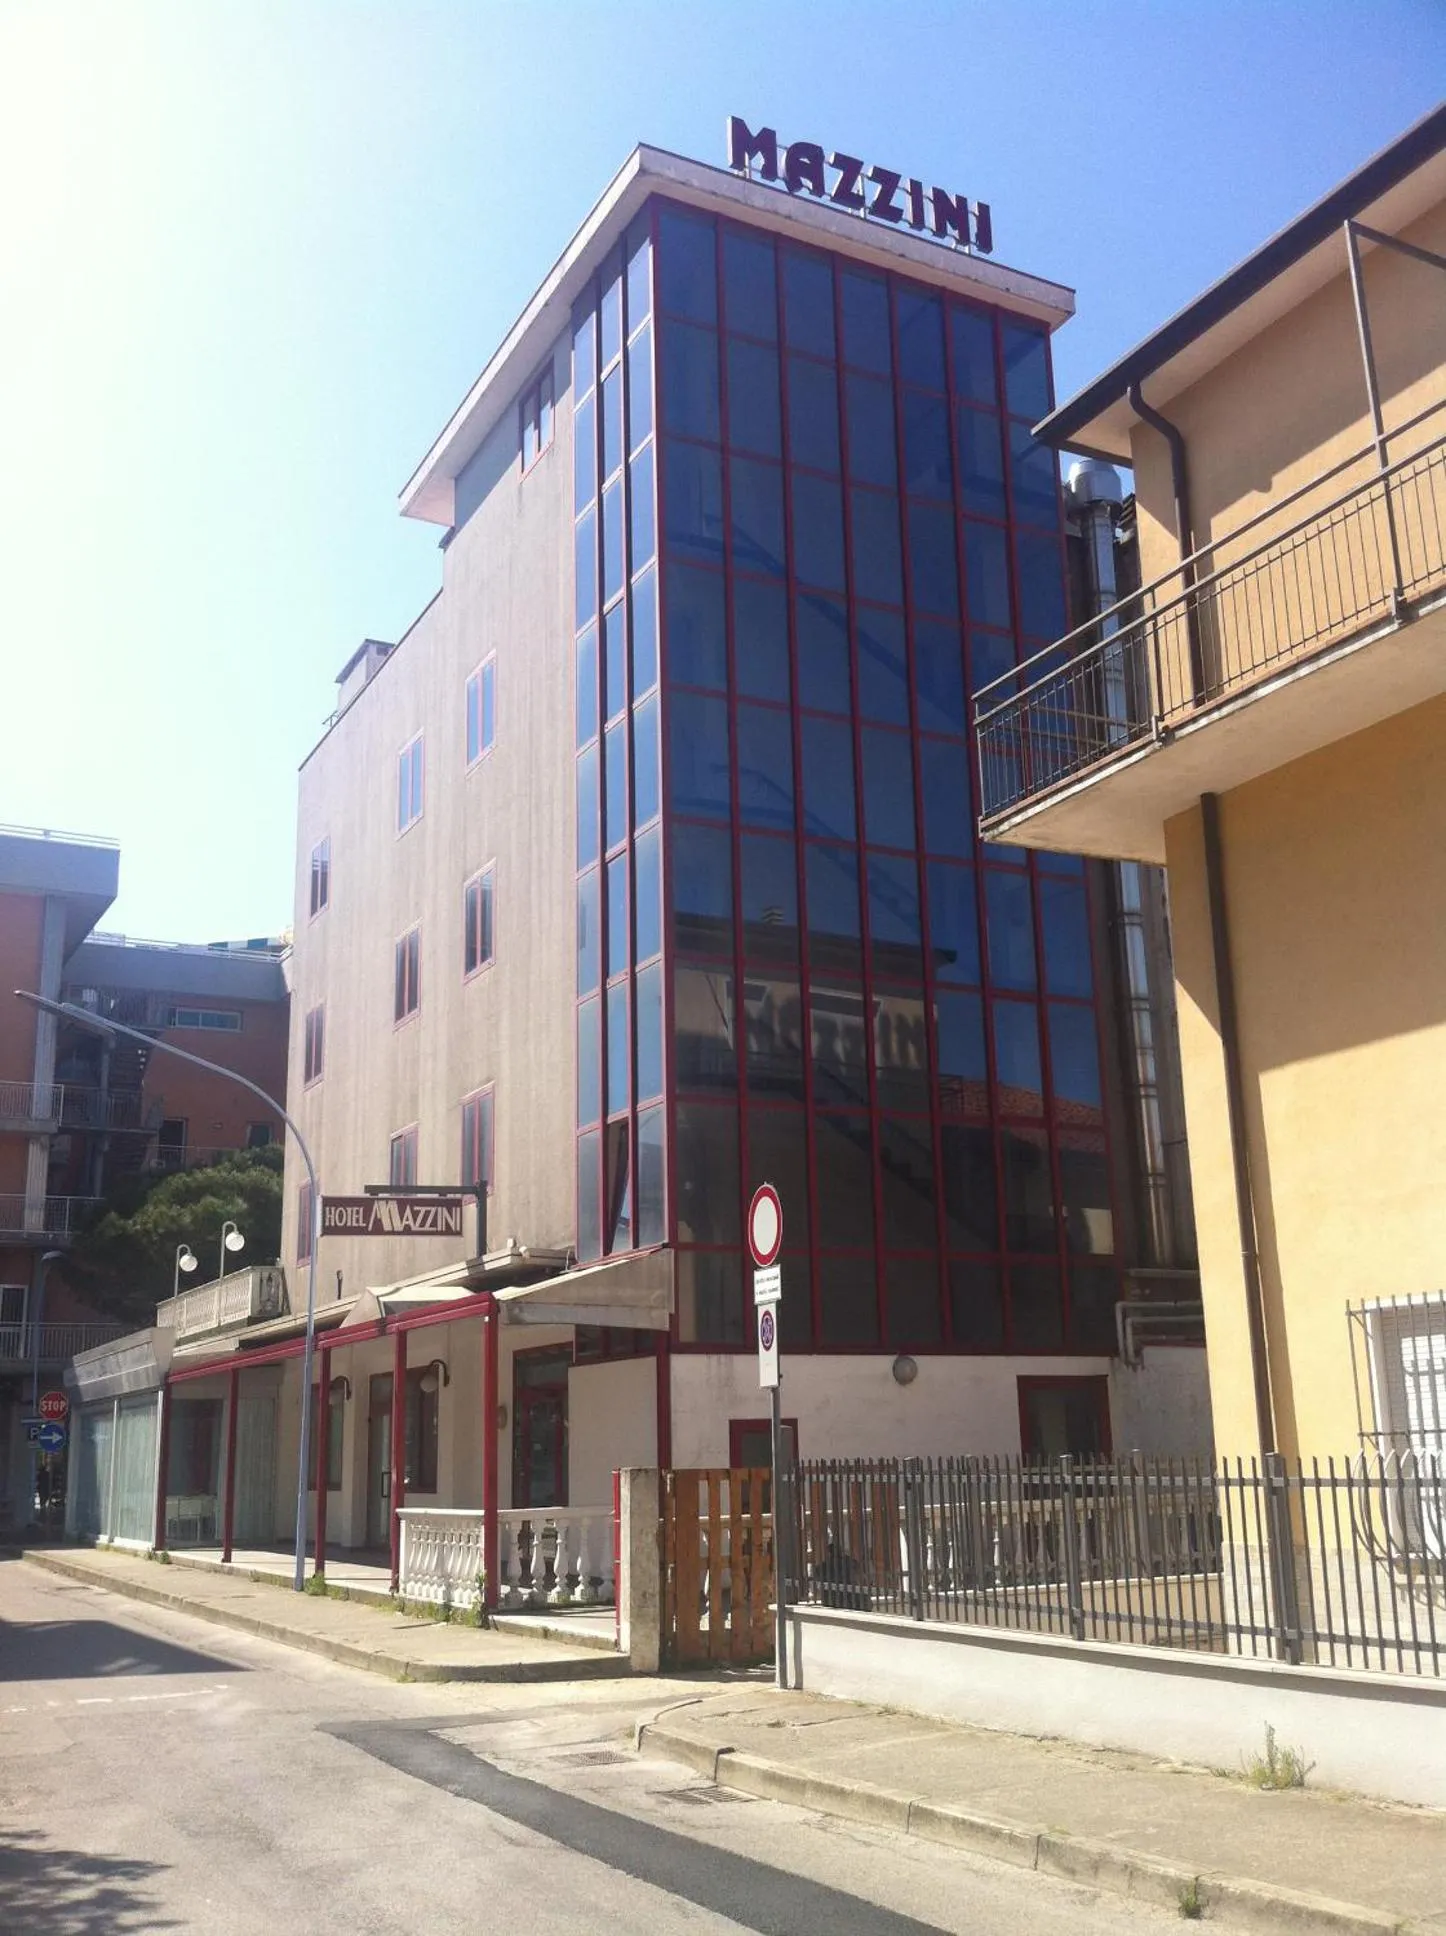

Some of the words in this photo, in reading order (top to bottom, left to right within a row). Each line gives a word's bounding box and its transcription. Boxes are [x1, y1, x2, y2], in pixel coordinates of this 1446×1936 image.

[727, 115, 993, 254] MAZZINI
[325, 1206, 366, 1227] HOTEL
[368, 1199, 461, 1232] MAZZINI
[41, 1400, 66, 1412] STOP
